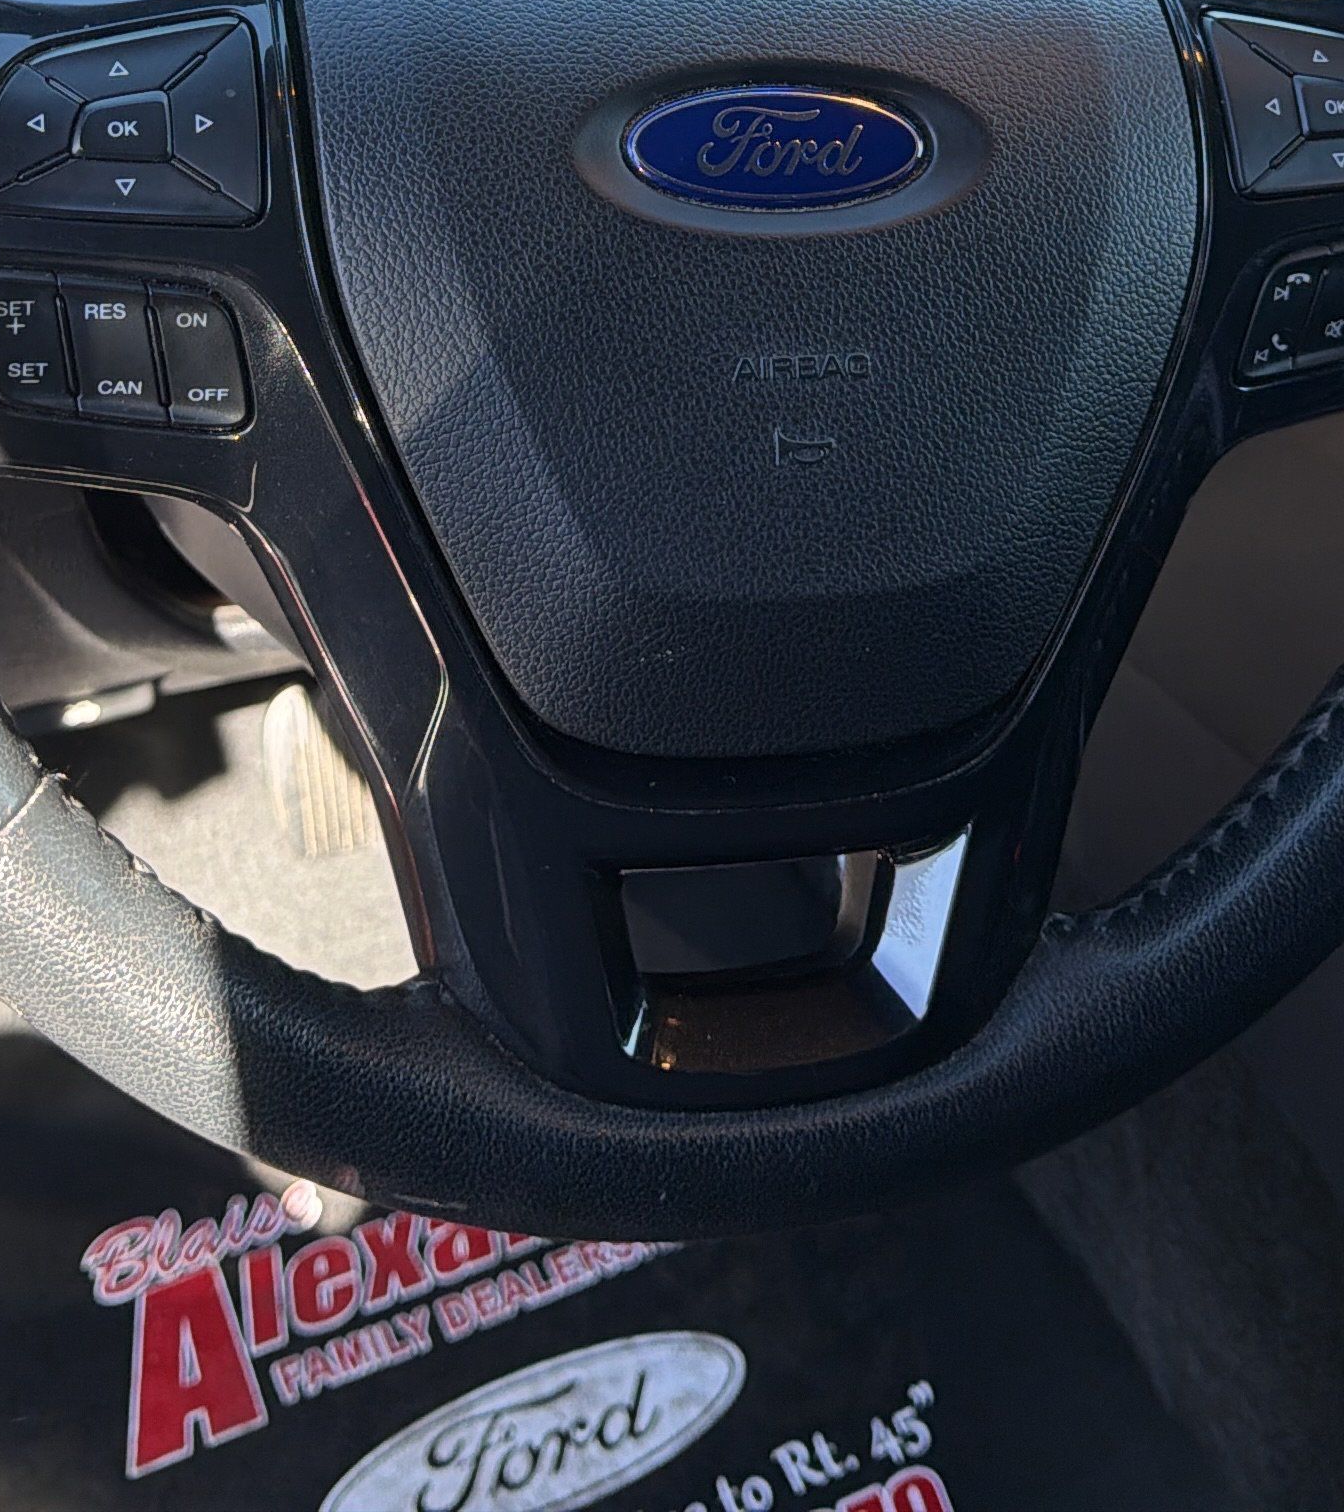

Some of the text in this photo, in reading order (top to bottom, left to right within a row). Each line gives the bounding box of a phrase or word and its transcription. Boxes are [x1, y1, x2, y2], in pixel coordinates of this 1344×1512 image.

[107, 120, 139, 137] OK
[696, 105, 865, 177] Ford
[84, 303, 127, 320] RES
[175, 312, 208, 328] ON
[7, 362, 48, 378] SET
[732, 352, 872, 381] AIRBAG
[97, 380, 143, 395] CAN
[187, 388, 229, 403] OFF
[80, 1178, 323, 1307] Blaise
[125, 1210, 553, 1480] Alexa
[269, 1304, 433, 1406] FAMILY
[416, 1369, 660, 1512] Ford
[769, 1431, 860, 1495] Rt.
